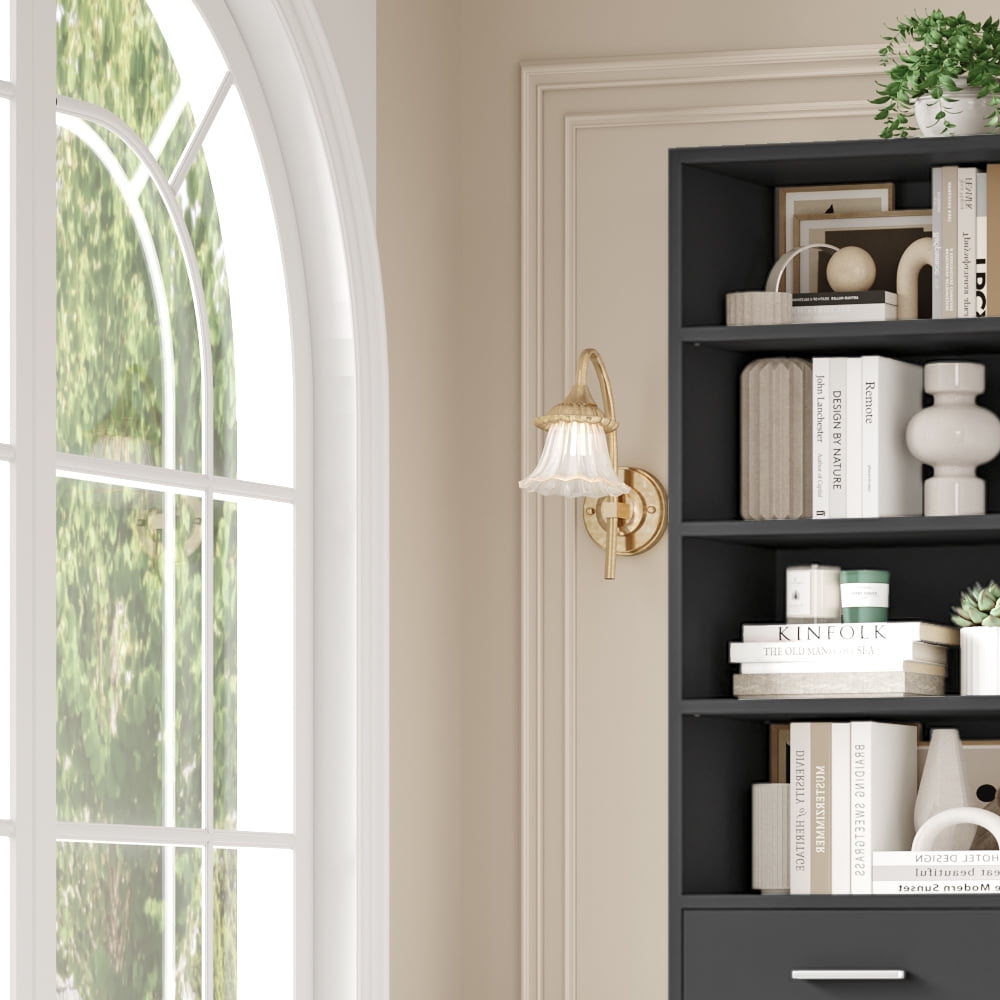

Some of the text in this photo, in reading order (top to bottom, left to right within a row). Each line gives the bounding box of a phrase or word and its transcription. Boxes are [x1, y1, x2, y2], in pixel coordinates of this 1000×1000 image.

[815, 375, 825, 443] John Lanchester
[864, 382, 876, 424] Remote
[833, 390, 842, 490] DESIGN BY NATURE
[764, 647, 783, 656] THE
[784, 647, 804, 656] OLD
[778, 625, 888, 641] KINFOLK
